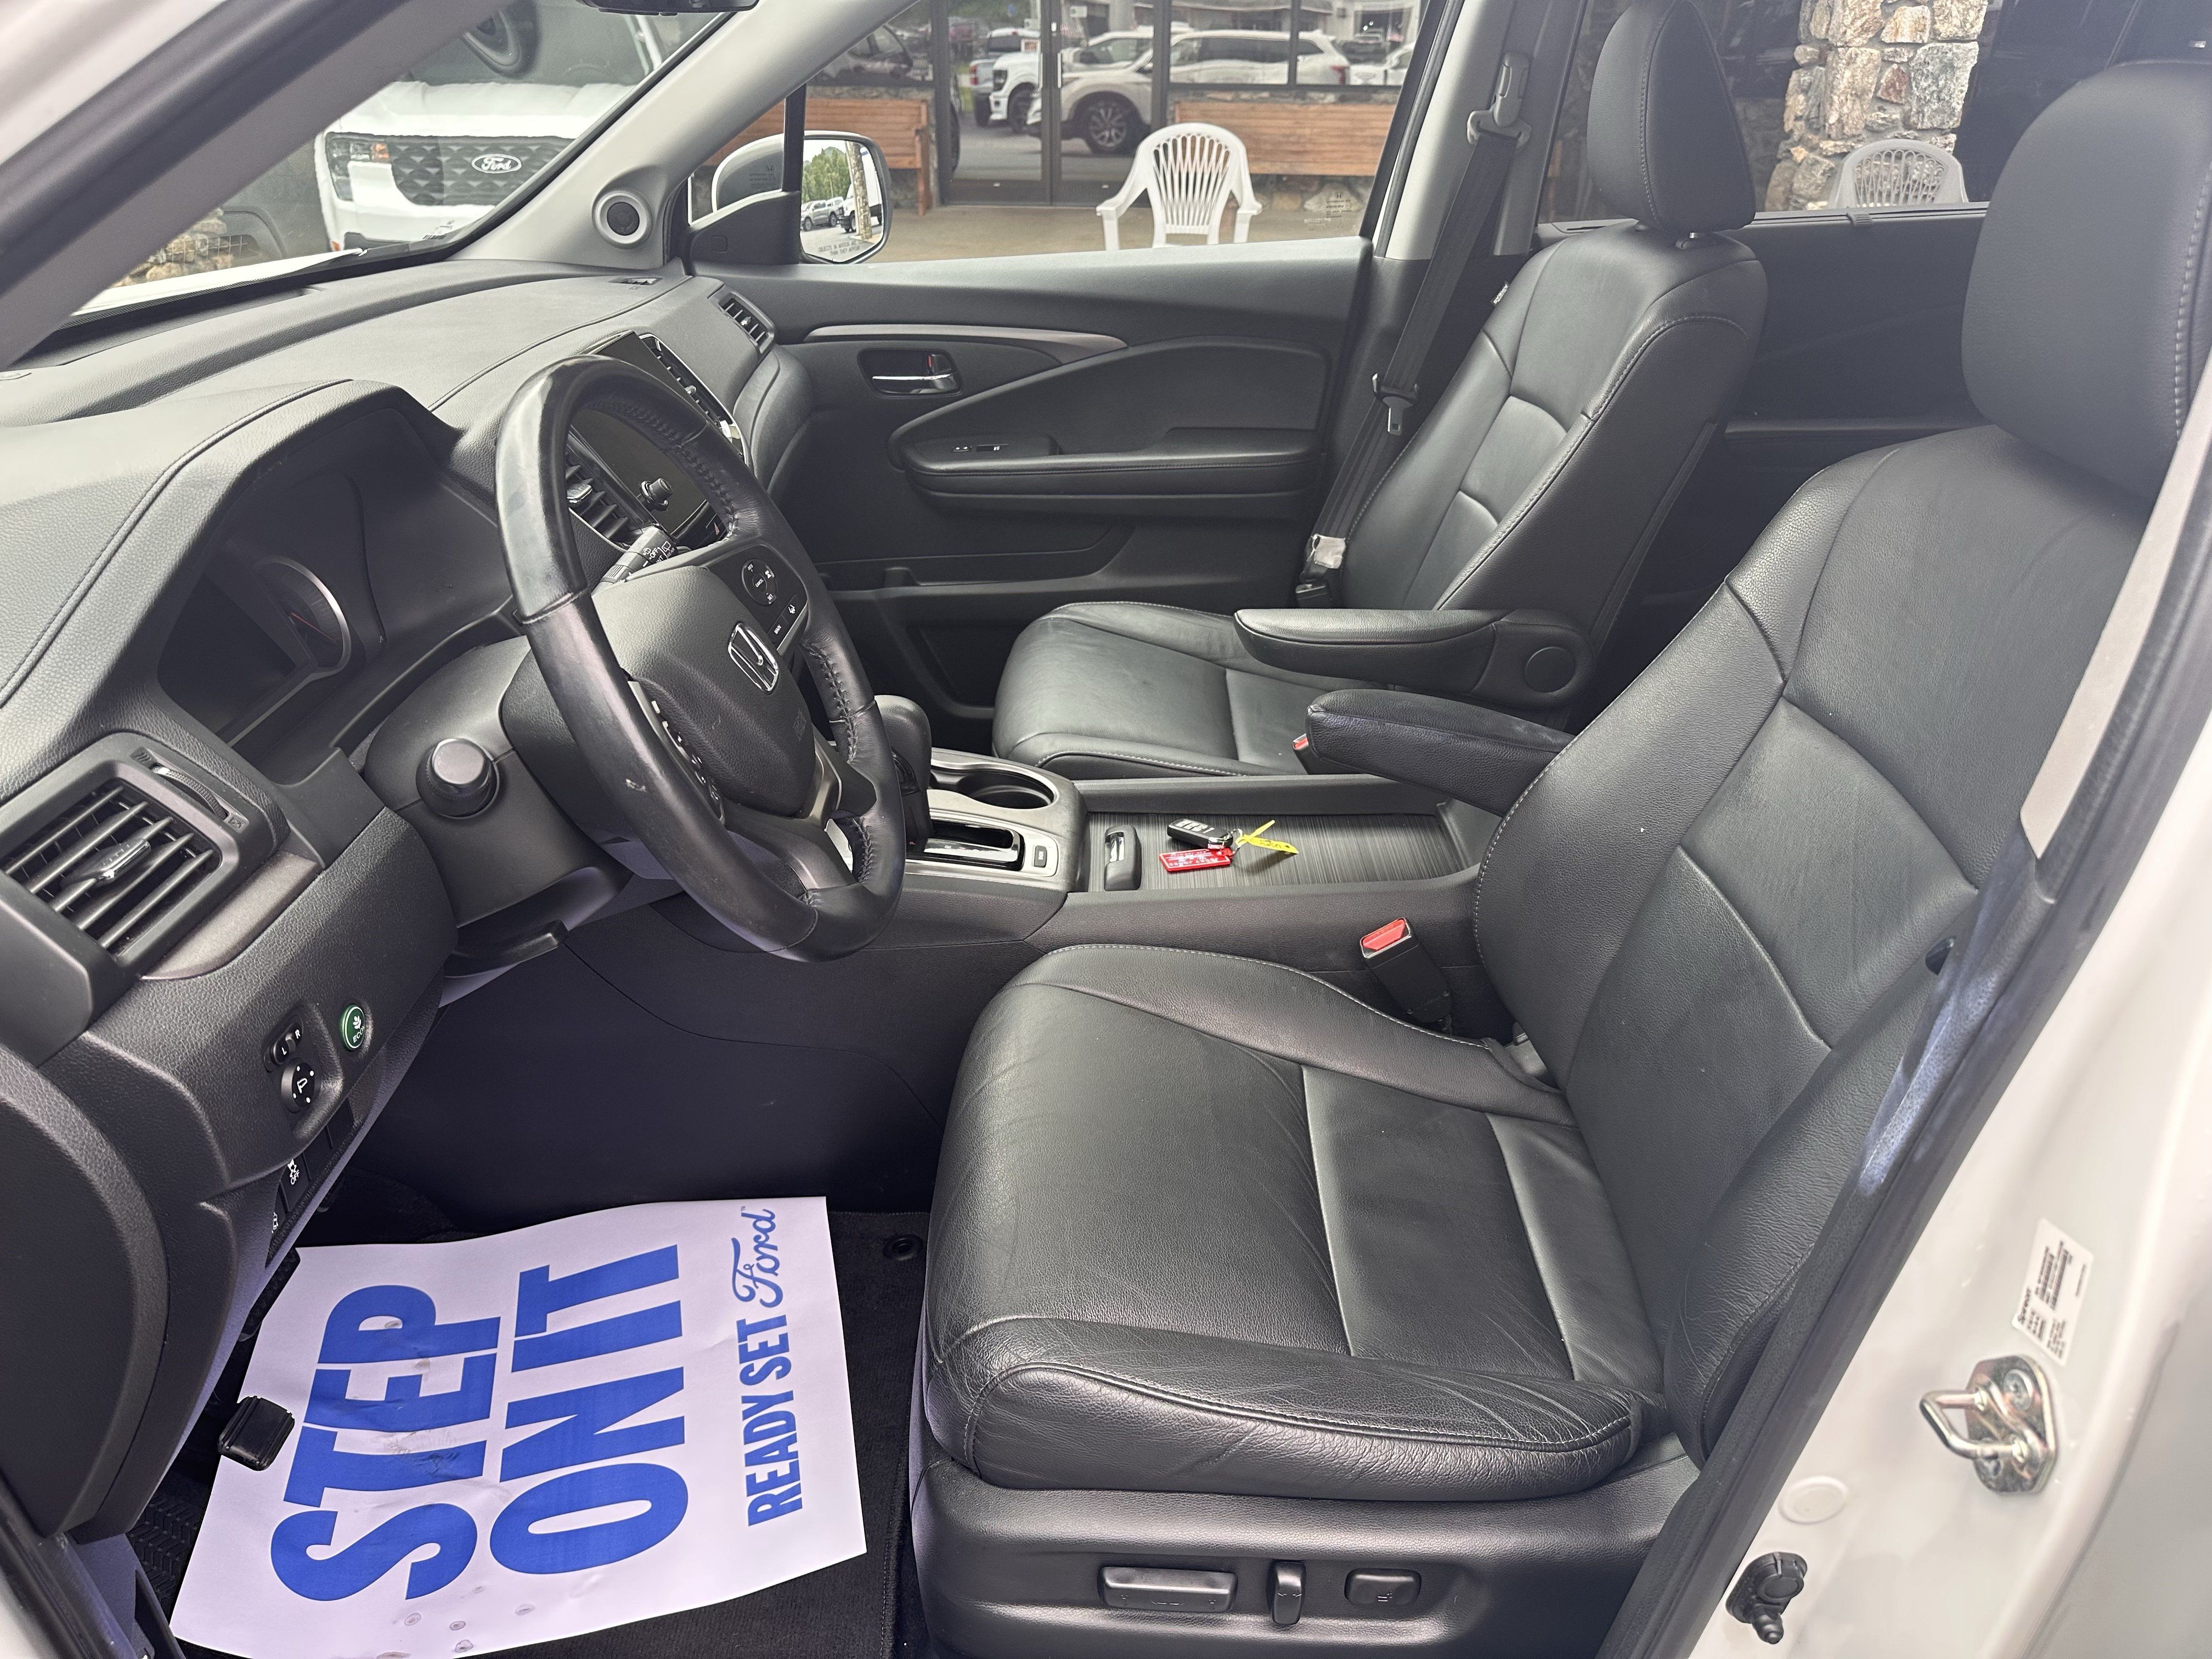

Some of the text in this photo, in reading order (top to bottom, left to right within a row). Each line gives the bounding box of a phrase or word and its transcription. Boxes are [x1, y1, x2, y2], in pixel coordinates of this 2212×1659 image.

[481, 157, 511, 171] Ford
[650, 547, 658, 558] OFF
[295, 1029, 301, 1039] R
[281, 1047, 287, 1055] L
[290, 1169, 300, 1185] OFF
[731, 1209, 802, 1526] READY SET Ford
[489, 1245, 687, 1575] ON IT
[270, 1285, 500, 1601] STEP
